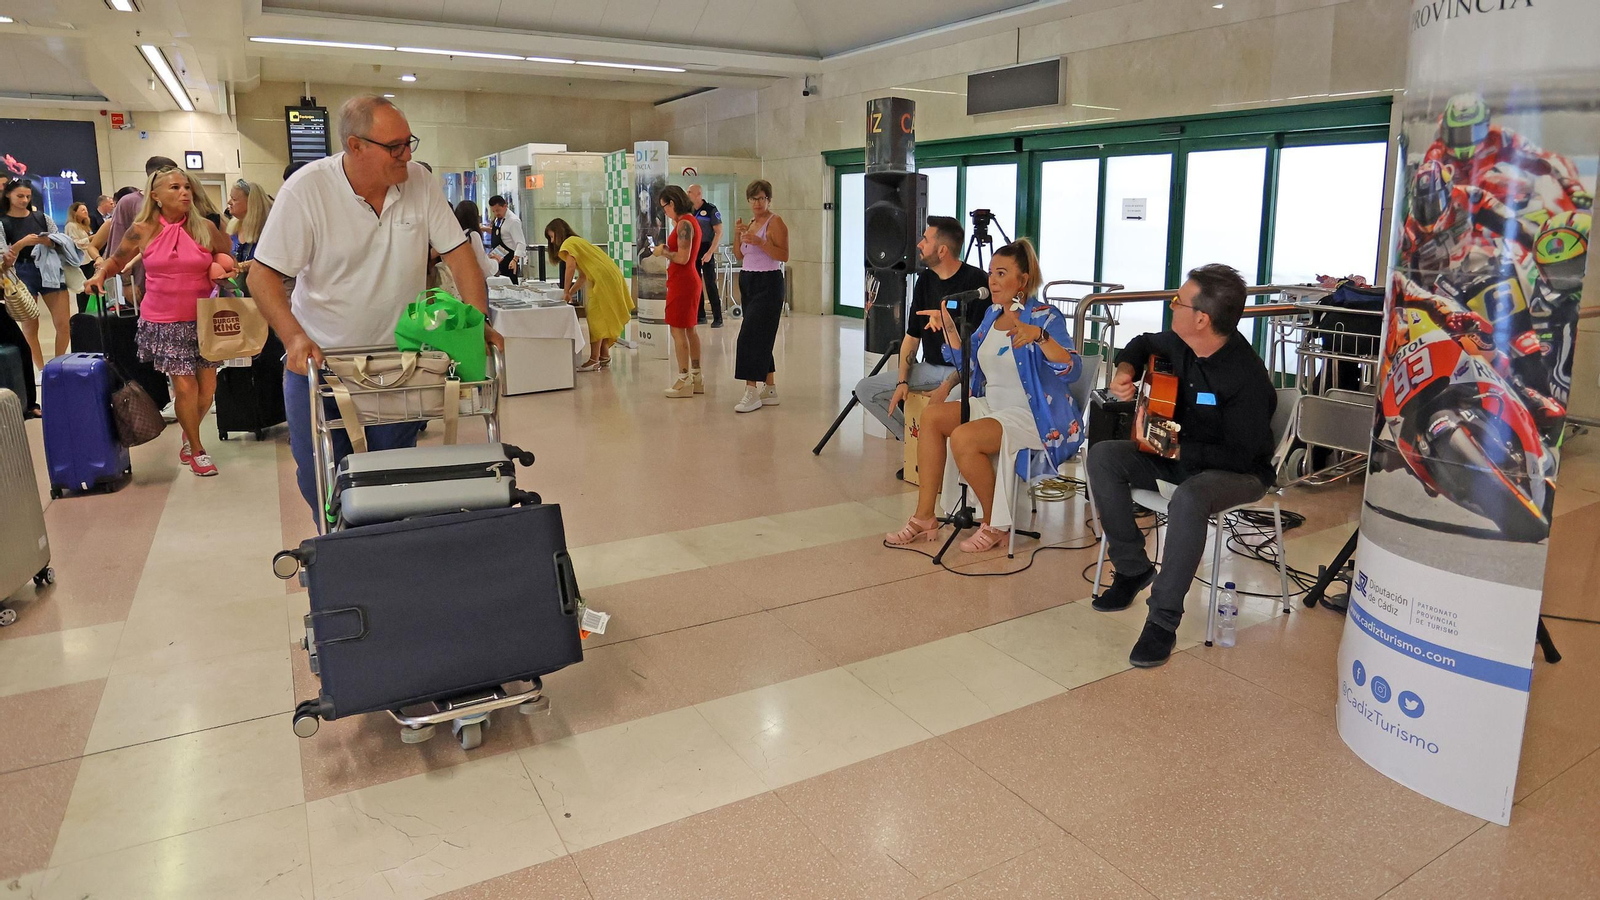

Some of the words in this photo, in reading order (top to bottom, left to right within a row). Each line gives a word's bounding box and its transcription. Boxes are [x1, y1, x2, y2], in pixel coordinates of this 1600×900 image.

[212, 317, 240, 325] BURGER
[213, 323, 241, 332] KING
[1393, 346, 1434, 406] 93
[1368, 579, 1409, 607] Diputación
[1367, 593, 1377, 604] de
[1377, 597, 1399, 617] Cádiz
[1417, 601, 1459, 620] PATRONATO
[1415, 617, 1425, 626] DE
[1427, 621, 1459, 636] TURISMO
[1416, 610, 1457, 628] PROVINCIAL
[1342, 680, 1440, 754] @CadizTurismo
